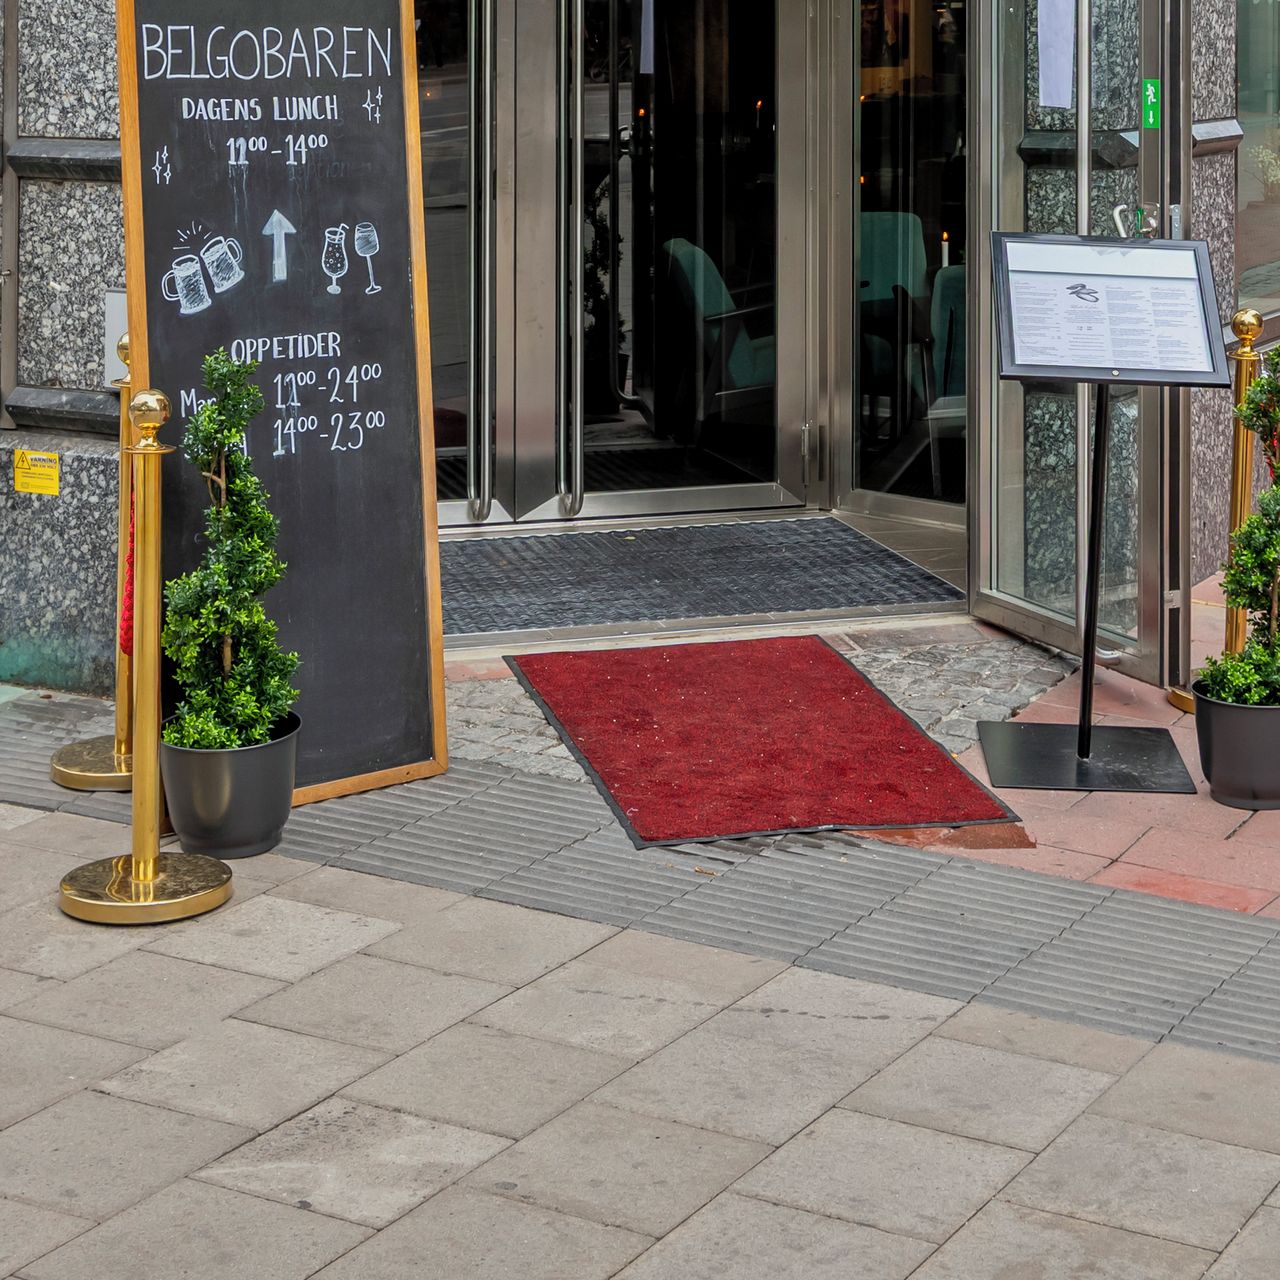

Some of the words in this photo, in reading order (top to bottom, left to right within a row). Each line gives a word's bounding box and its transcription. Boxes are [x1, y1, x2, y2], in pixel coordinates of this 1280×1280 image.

[142, 23, 392, 80] BELGOBAREN
[181, 97, 262, 120] DAGENS
[272, 94, 339, 121] LUNCH
